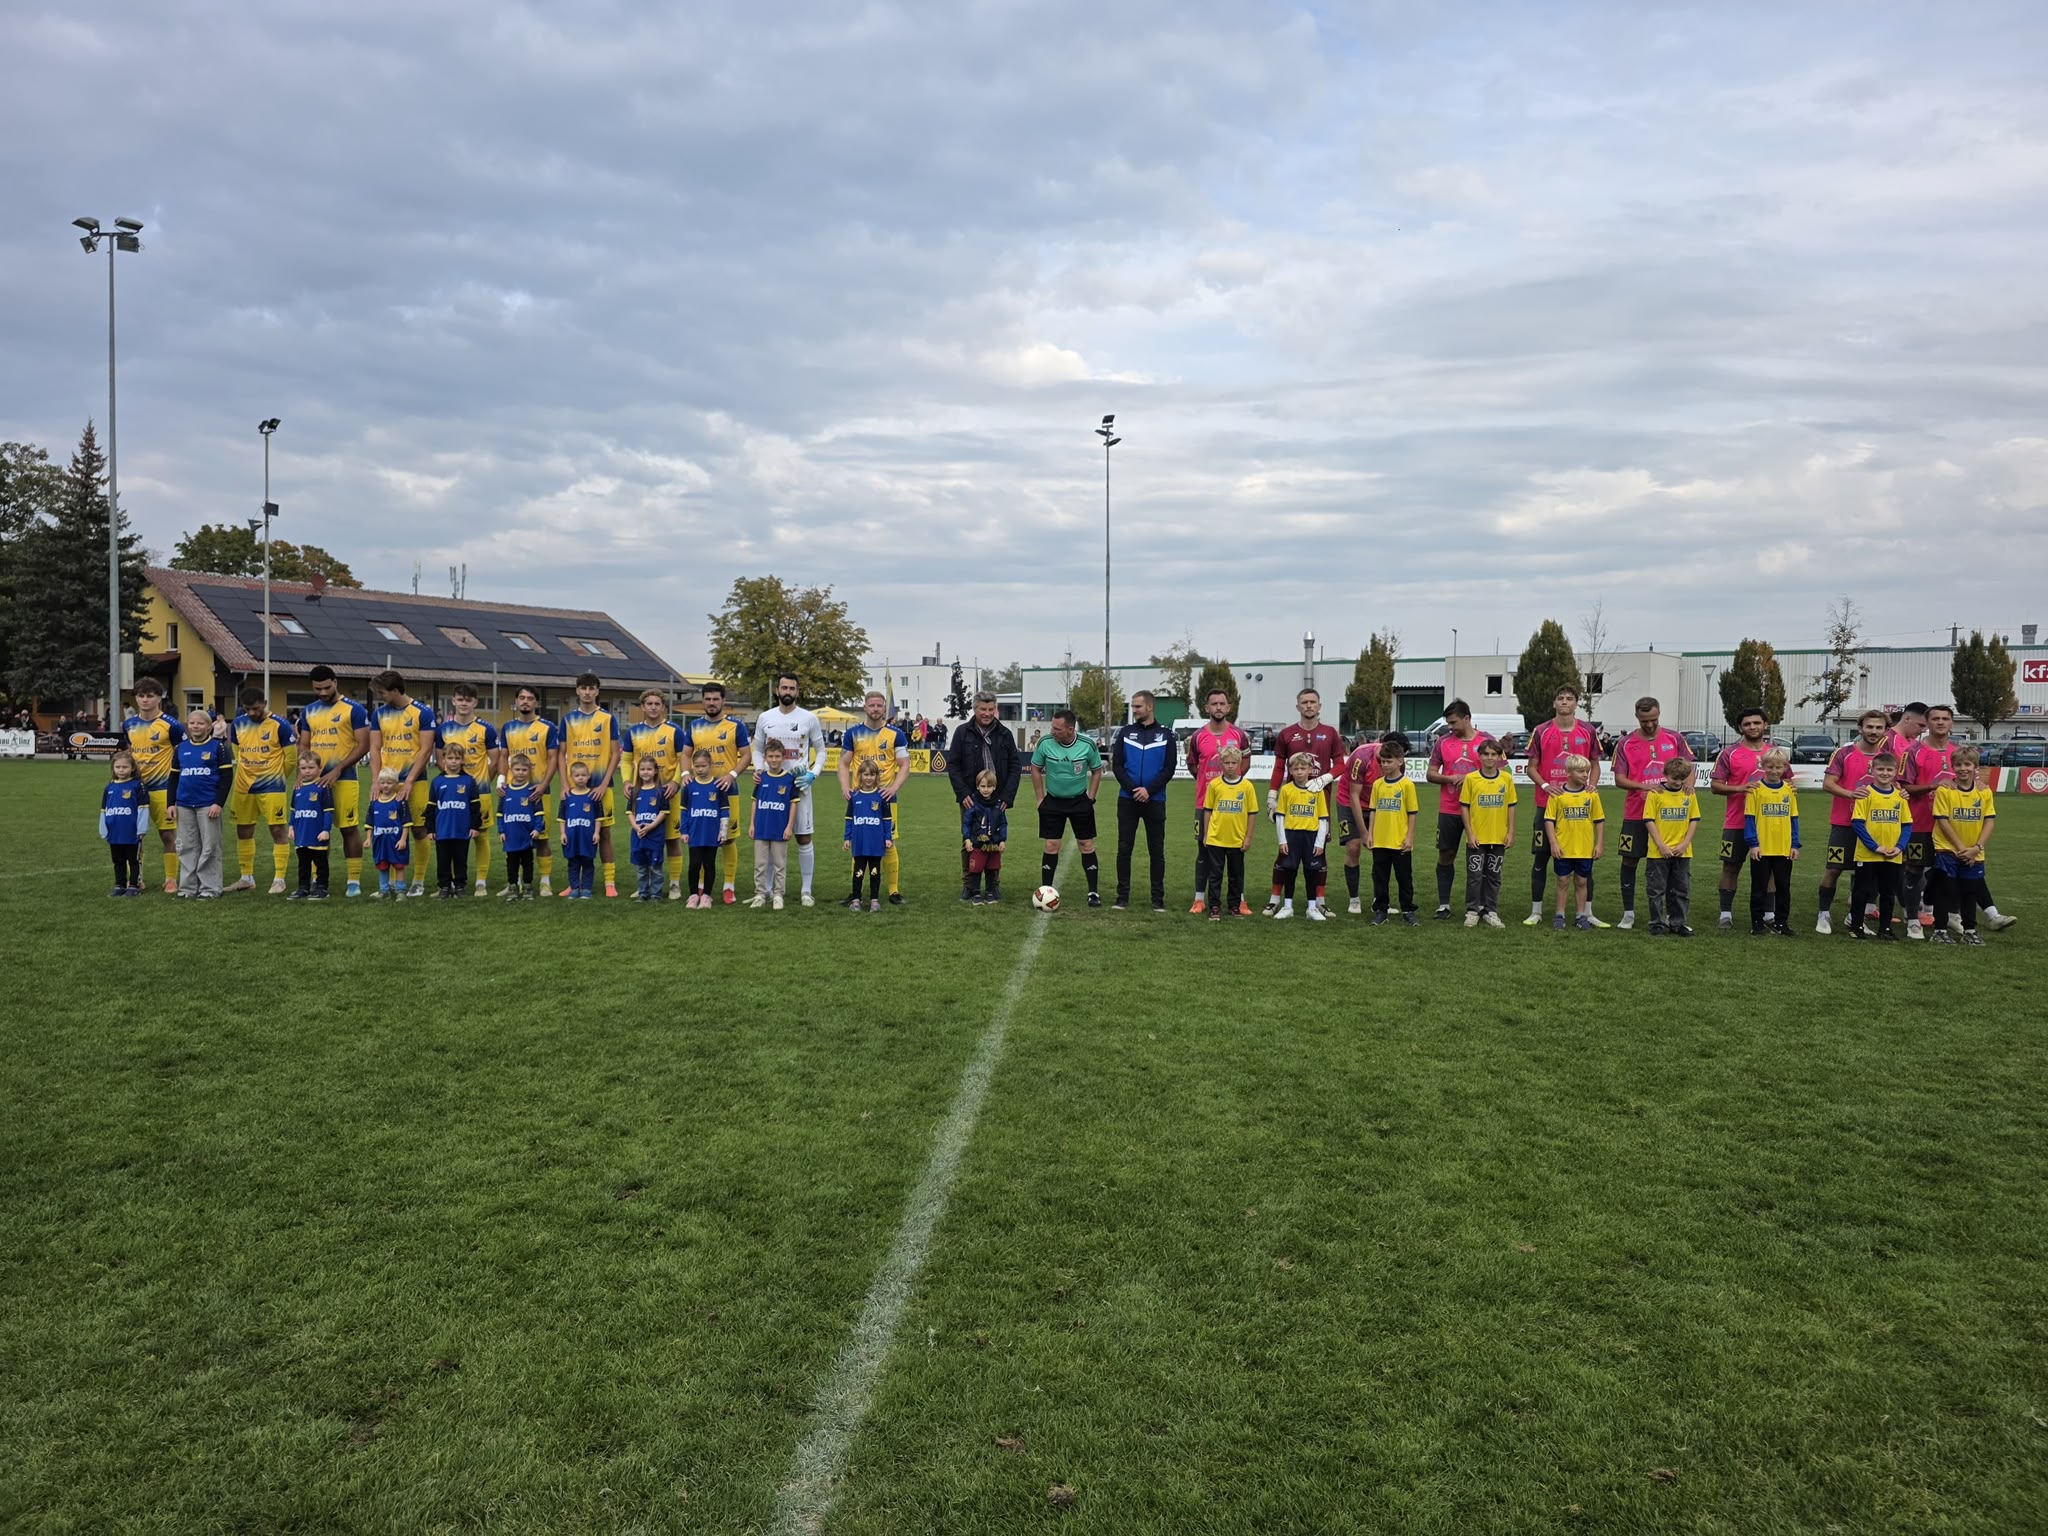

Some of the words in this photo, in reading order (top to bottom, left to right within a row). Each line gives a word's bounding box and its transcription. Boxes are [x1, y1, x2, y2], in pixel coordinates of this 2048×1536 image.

[2025, 664, 2048, 679] kf
[436, 799, 467, 810] Lenze
[757, 799, 785, 811] Lenze
[294, 809, 318, 819] enze
[503, 813, 532, 823] Lenze
[635, 812, 657, 822] enze
[690, 807, 718, 818] Lenze
[853, 815, 881, 826] Lenze
